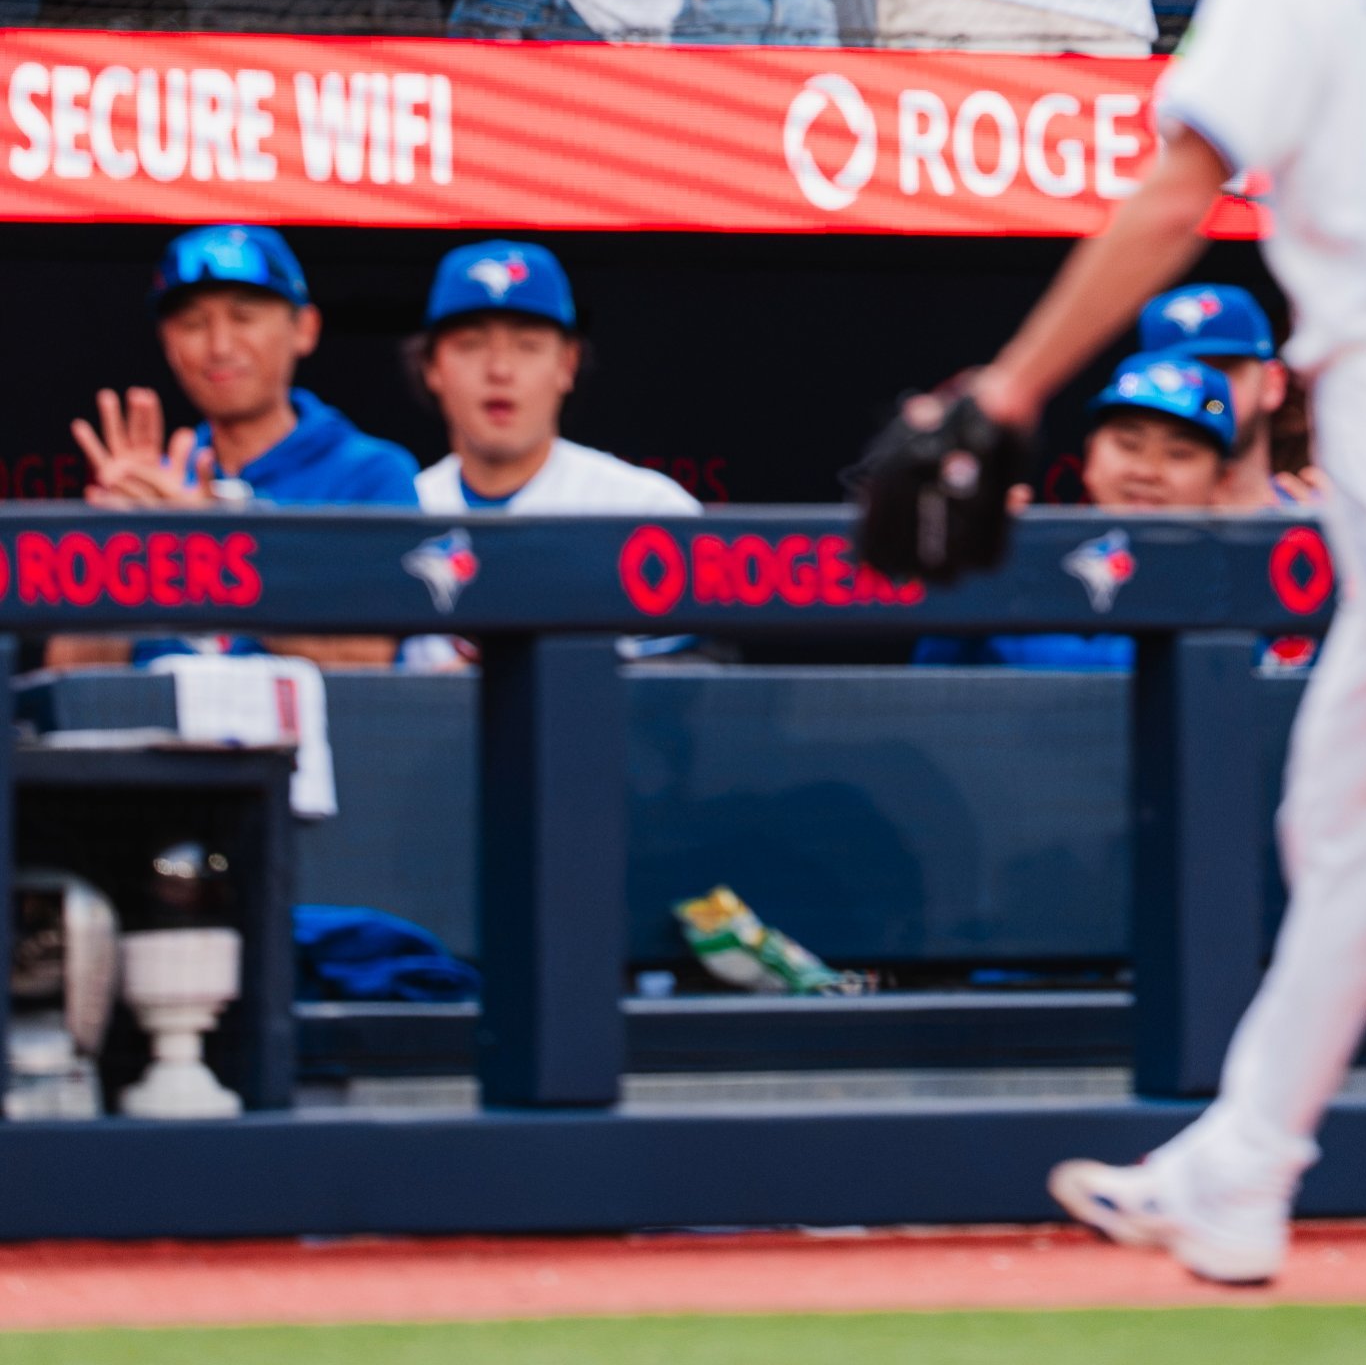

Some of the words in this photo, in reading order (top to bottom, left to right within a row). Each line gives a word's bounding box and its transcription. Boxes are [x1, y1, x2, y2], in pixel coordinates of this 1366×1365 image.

[8, 61, 278, 183] SECURE
[294, 71, 454, 186] WIFI
[898, 88, 1142, 201] ROGE
[16, 532, 263, 608] ROGERS
